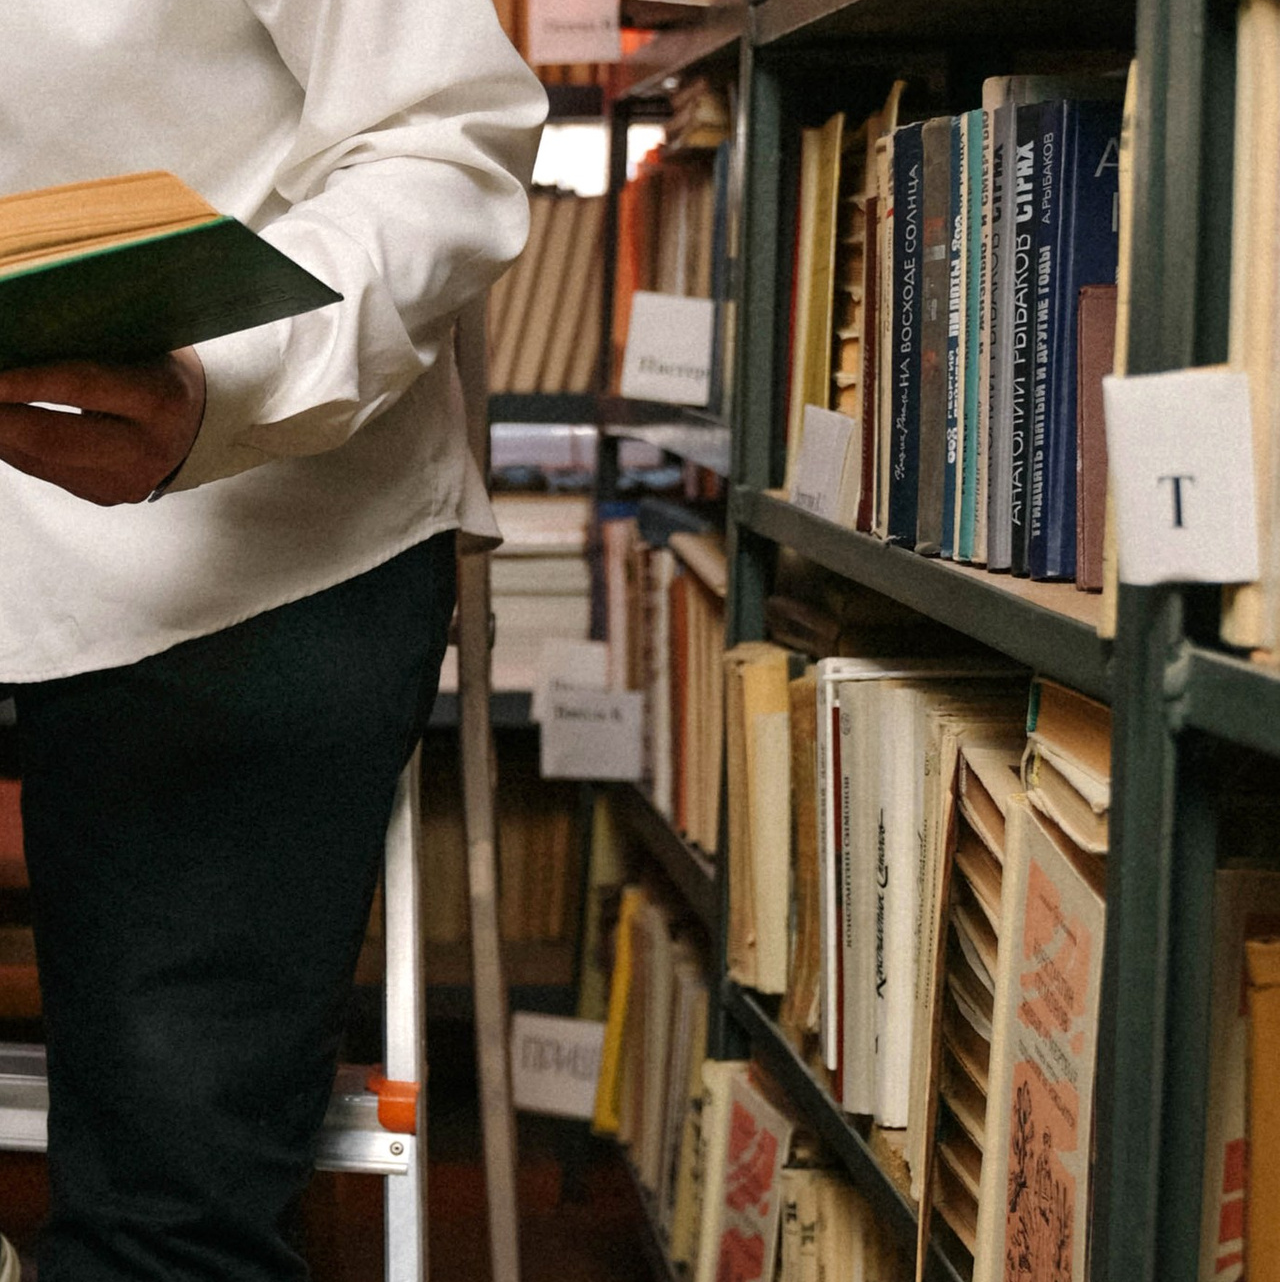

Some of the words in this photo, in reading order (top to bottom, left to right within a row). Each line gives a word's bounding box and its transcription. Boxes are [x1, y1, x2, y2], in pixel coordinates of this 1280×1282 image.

[903, 163, 920, 254] СОЛНЦА
[1016, 140, 1036, 224] СТРАХ
[1041, 131, 1055, 225] А.РЫБАКОВ
[899, 257, 917, 354] ВОСХОДЕ
[1014, 232, 1032, 365] РЫБАКОВ
[1037, 244, 1052, 295] ГОДЫ
[1035, 299, 1051, 365] ДРУГИЕ
[898, 358, 911, 388] НА
[1035, 366, 1048, 381] И
[1034, 383, 1048, 447] ПЯТЫЙ
[1031, 450, 1046, 540] ТРИДЦАТЬ
[1156, 474, 1196, 530] Т
